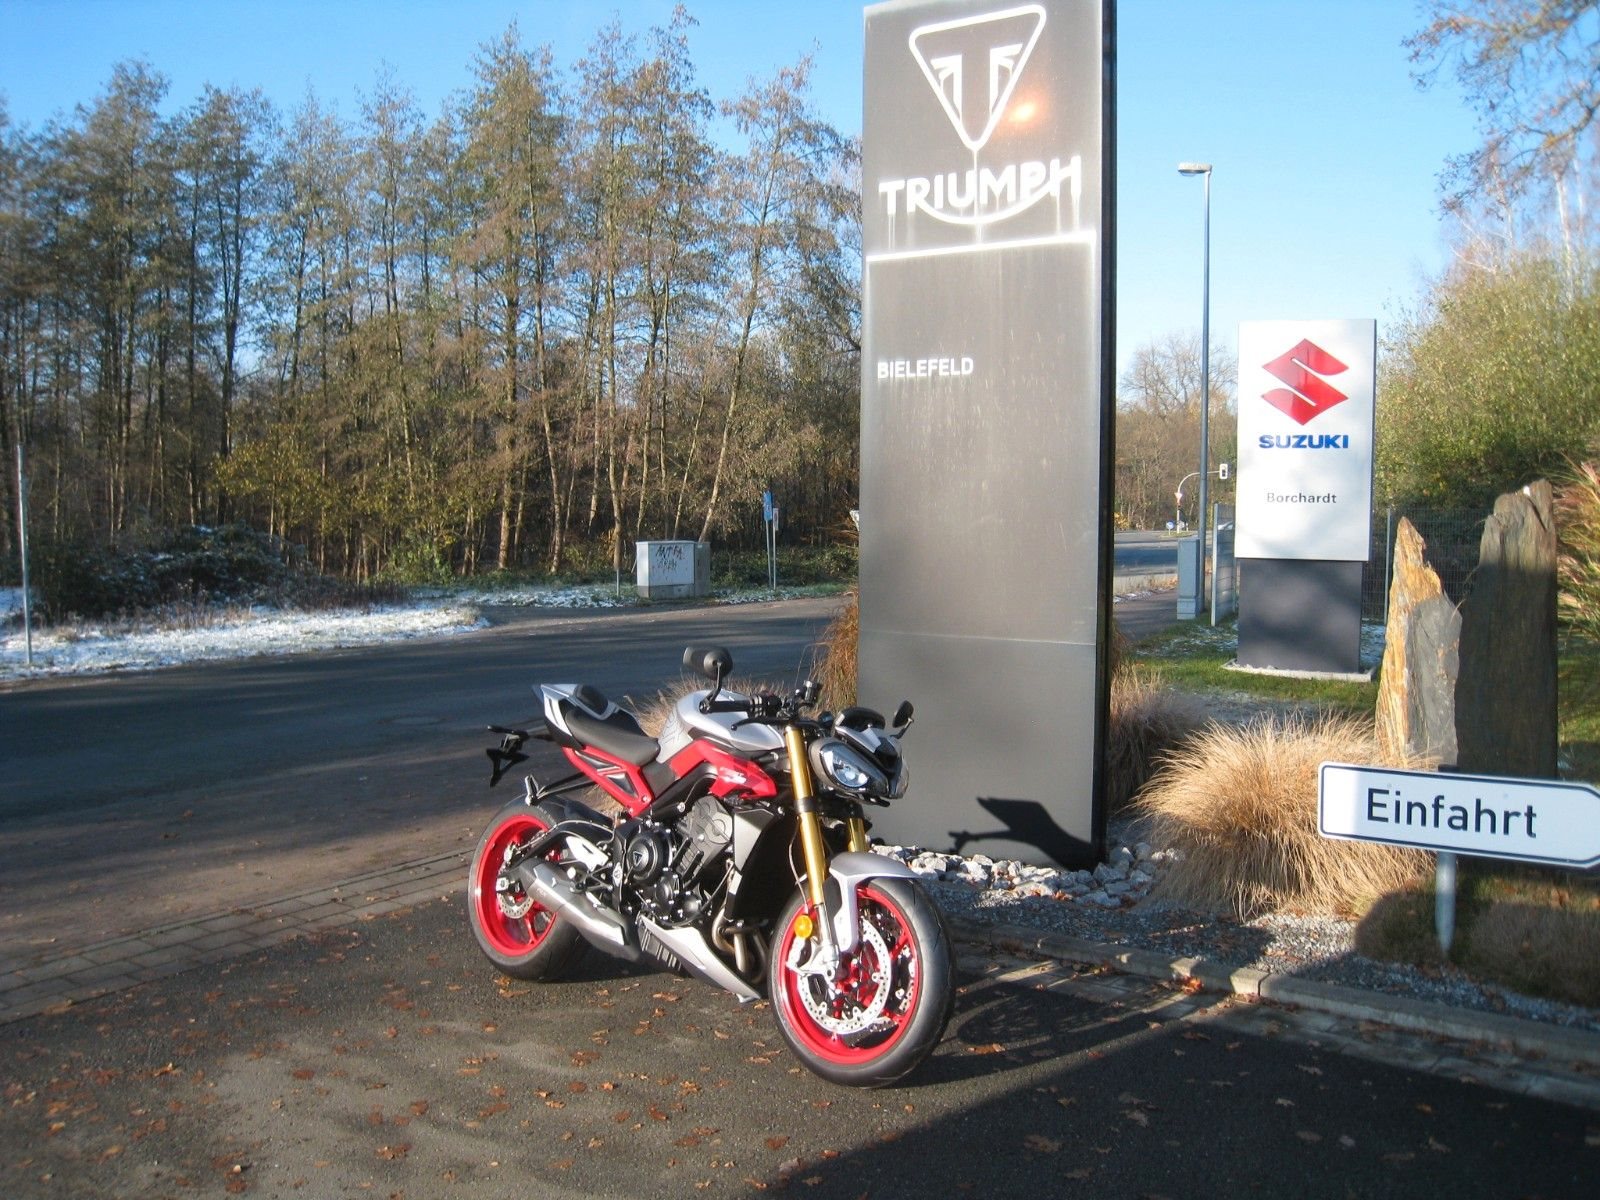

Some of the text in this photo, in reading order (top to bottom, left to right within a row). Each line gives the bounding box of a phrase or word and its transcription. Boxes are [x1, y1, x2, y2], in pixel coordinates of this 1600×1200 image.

[878, 155, 1082, 225] TRIUMPH
[877, 357, 974, 379] BIELEFELD
[1258, 434, 1349, 449] SUZUKI
[1266, 492, 1337, 504] Borchardt
[1367, 787, 1537, 839] Einfahrt
